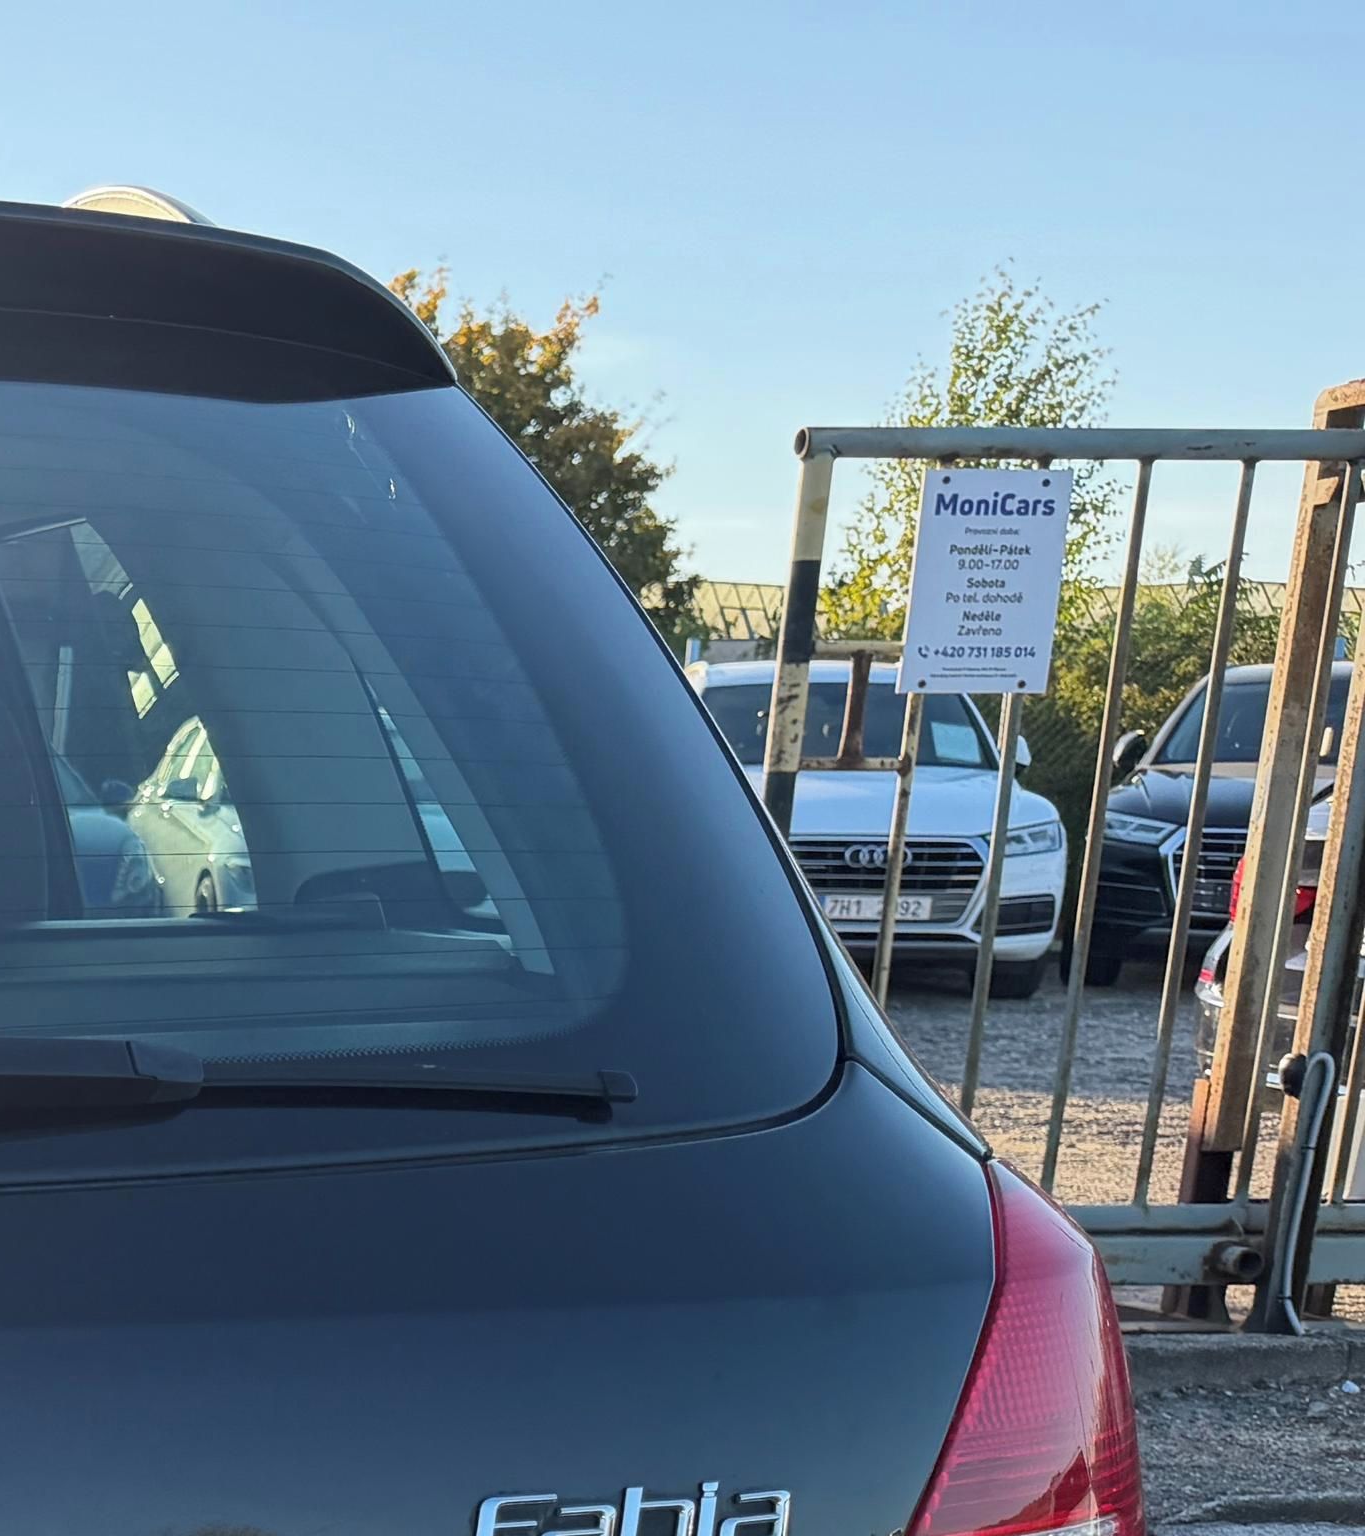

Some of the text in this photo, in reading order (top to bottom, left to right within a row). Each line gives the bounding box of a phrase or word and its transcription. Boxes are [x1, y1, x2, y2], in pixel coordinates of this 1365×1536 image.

[934, 491, 1056, 517] MoniCars
[957, 558, 1020, 570] 9.00-17.00
[966, 577, 1006, 589] Sobota
[945, 591, 1023, 604] Po tel. dohodě
[962, 610, 1002, 622] Neděle
[957, 624, 1003, 637] Zavřeno
[933, 646, 1036, 658] +420 731 185 014
